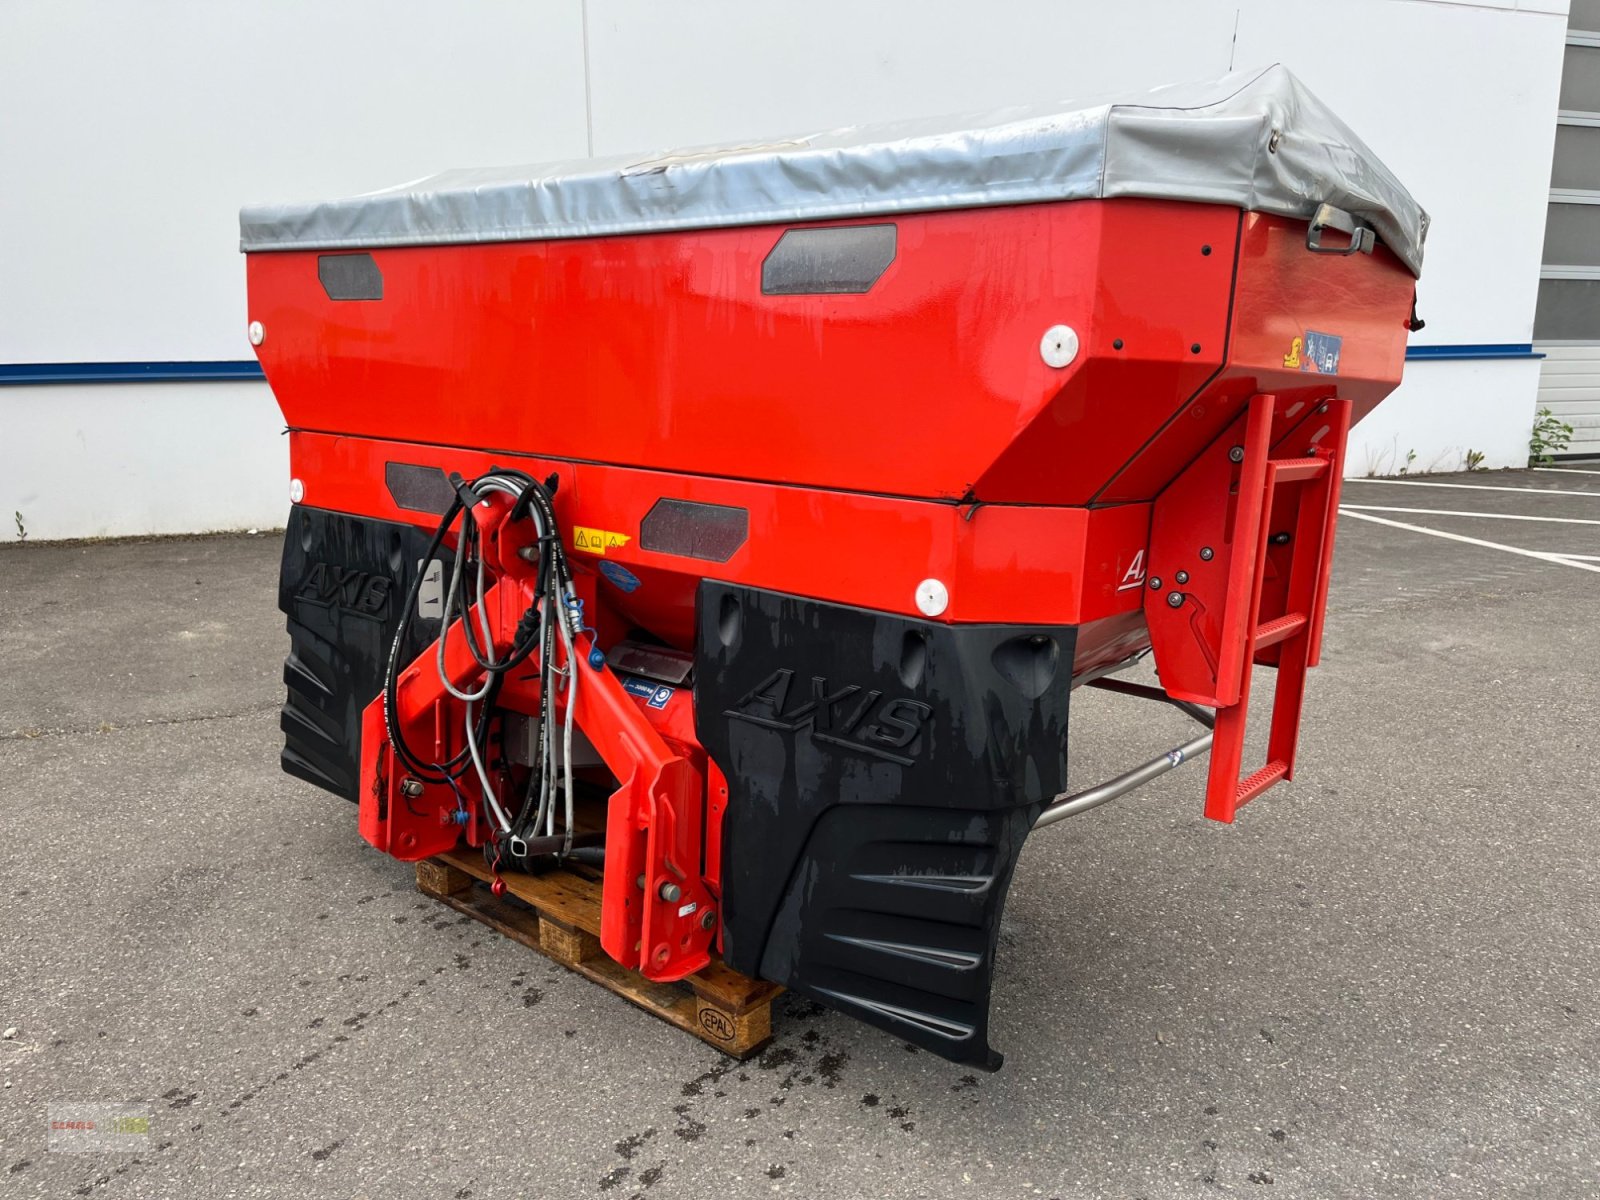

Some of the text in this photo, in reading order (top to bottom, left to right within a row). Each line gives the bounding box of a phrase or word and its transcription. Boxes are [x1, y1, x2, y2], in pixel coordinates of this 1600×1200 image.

[298, 562, 392, 614] AXIS
[1119, 549, 1146, 584] A
[732, 667, 934, 750] AXIS
[704, 1011, 730, 1037] EPAL
